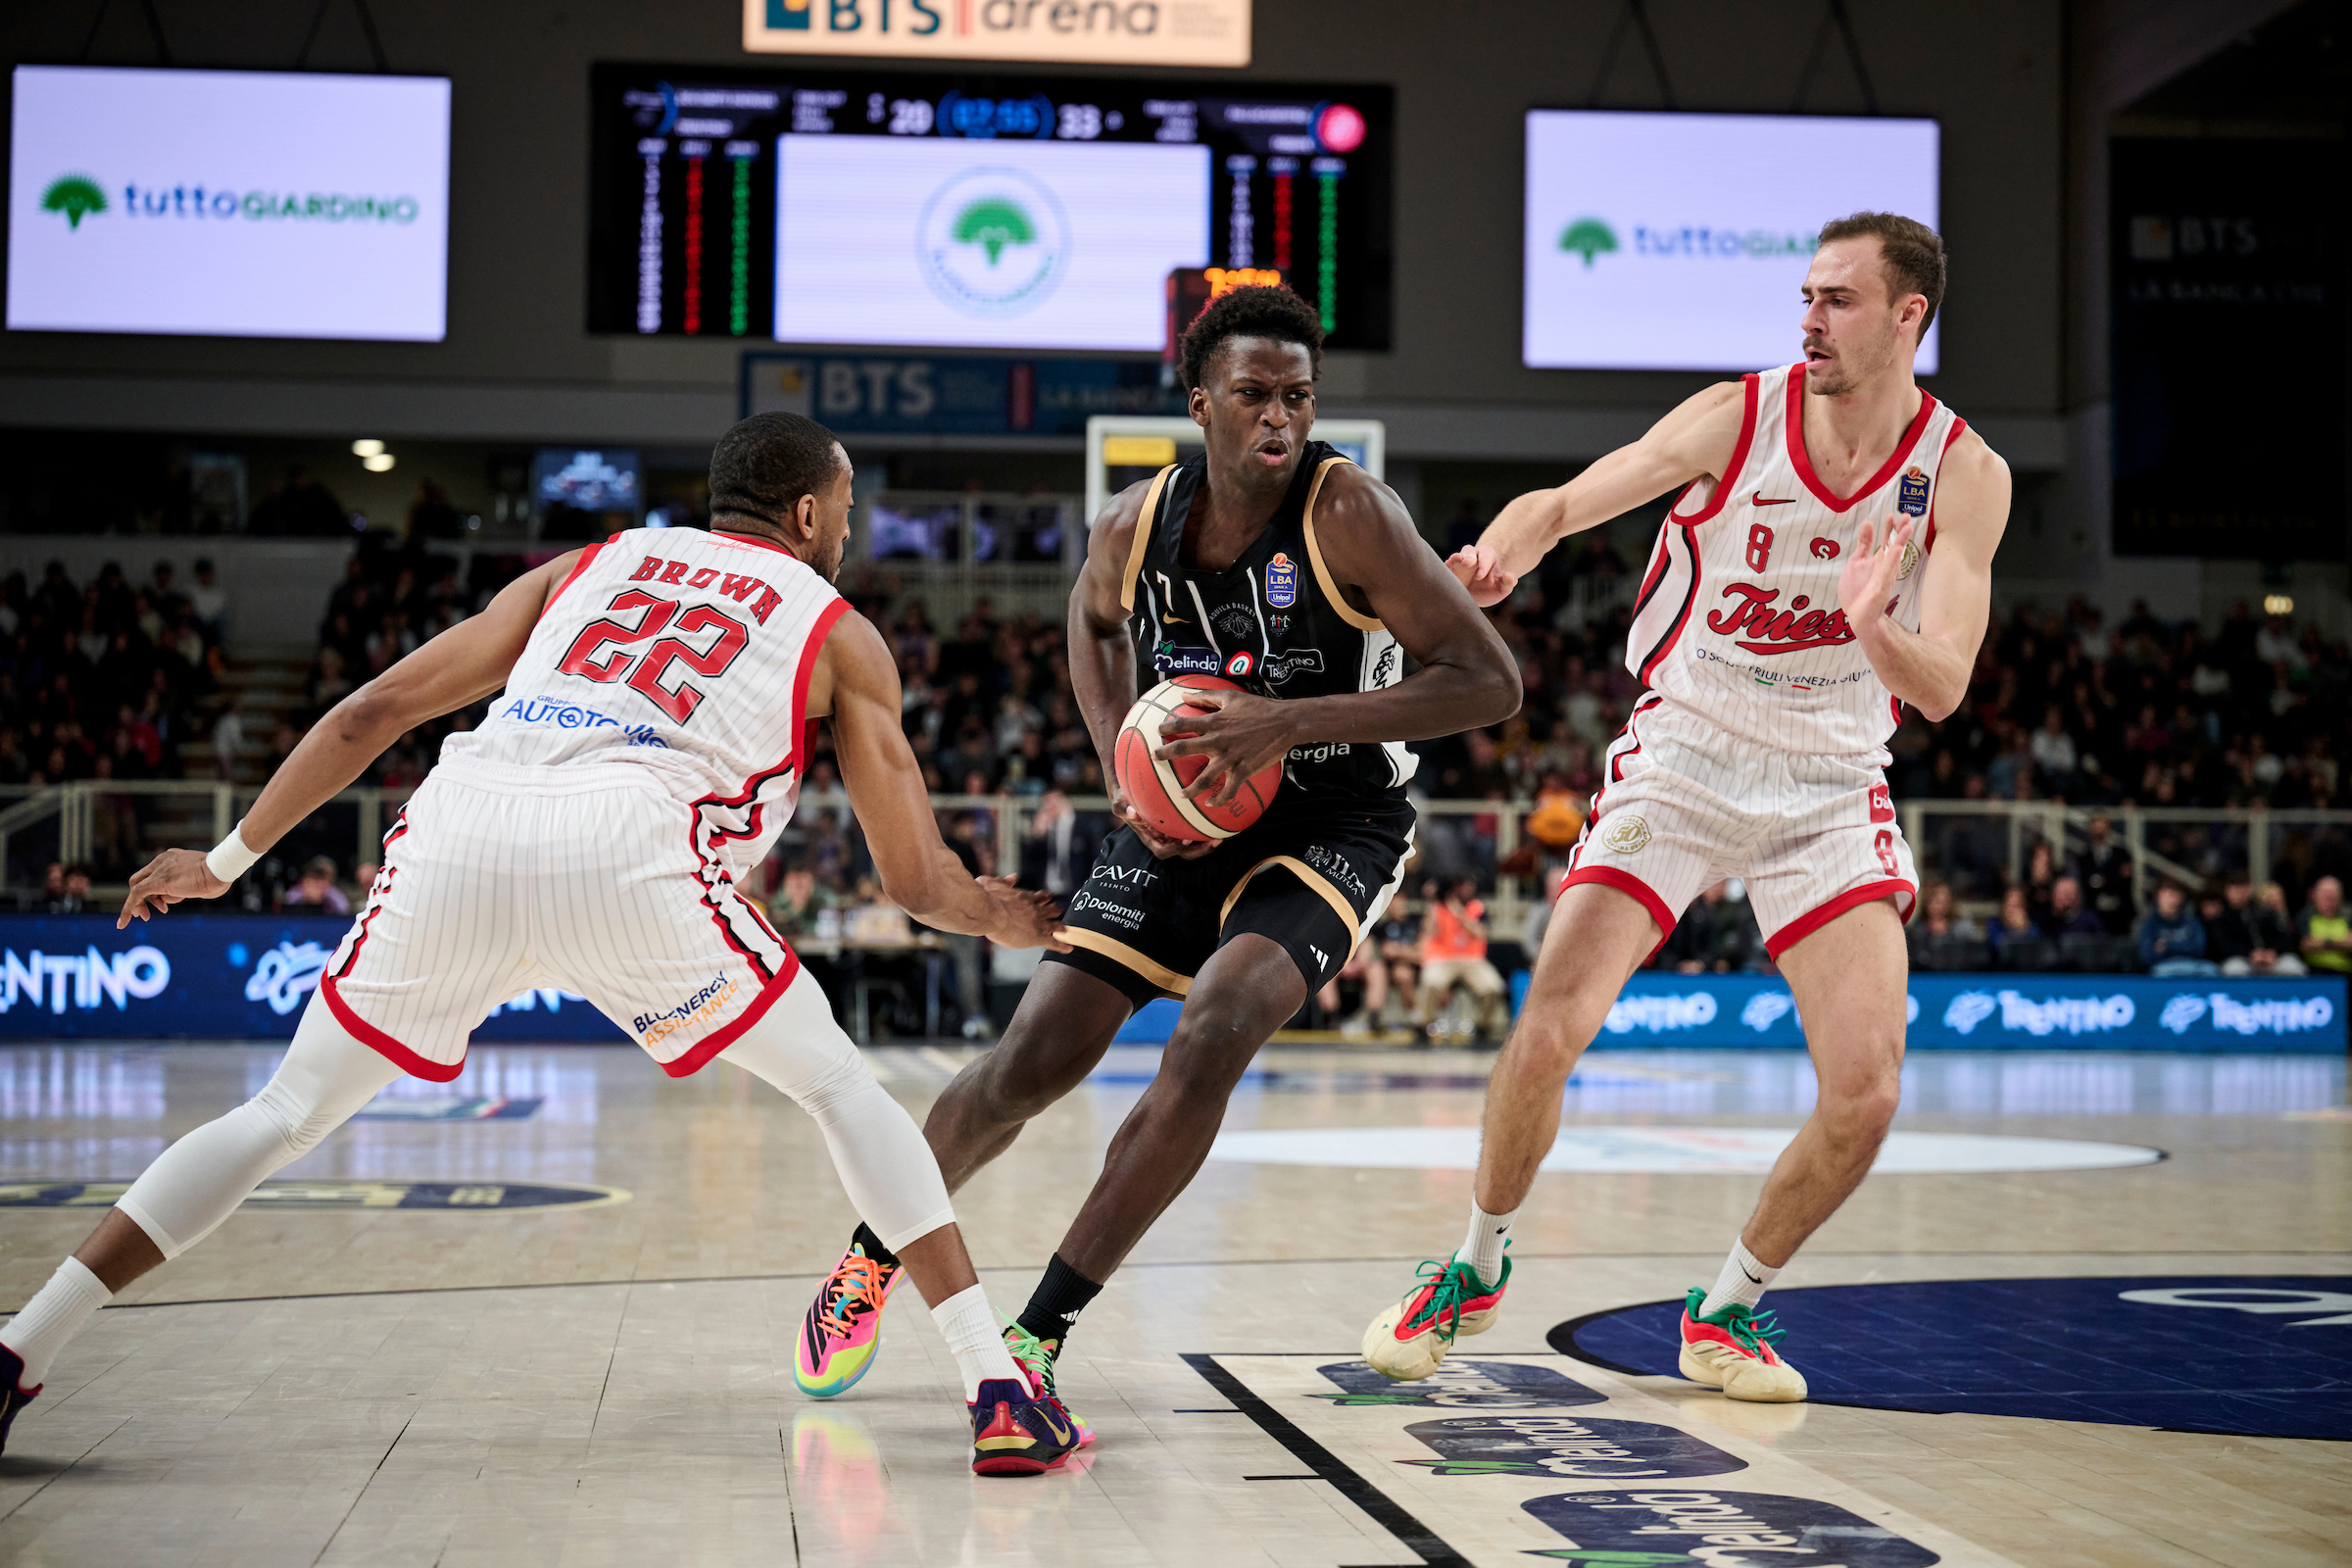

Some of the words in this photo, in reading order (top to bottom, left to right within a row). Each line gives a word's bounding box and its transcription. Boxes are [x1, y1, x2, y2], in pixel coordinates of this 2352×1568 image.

[982, 0, 1158, 35] arena
[820, 362, 936, 415] BTS
[1903, 486, 1926, 497] LBA
[1903, 504, 1923, 513] Unipol
[1745, 522, 1774, 574] 8
[629, 556, 783, 626] BROWN
[1155, 570, 1175, 612] 7
[1270, 575, 1293, 584] LBA
[1208, 604, 1231, 621] AQUILA
[1232, 602, 1256, 617] BASKET
[1707, 582, 1857, 640] Tries
[554, 588, 750, 726] 22
[1153, 653, 1218, 671] Melinda
[1749, 664, 1784, 682] FRIULI
[1787, 675, 1837, 687] VENEZIA
[537, 695, 575, 706] GRUPPO
[1284, 742, 1350, 763] ergia
[1612, 825, 1642, 843] 50
[1875, 829, 1899, 878] 8
[1092, 865, 1158, 888] CAVIT
[1100, 882, 1131, 893] TRENTO
[1326, 868, 1358, 896] MUTUA
[1088, 897, 1146, 922] Dolomiti
[1102, 912, 1140, 930] energia
[0, 945, 172, 1015] NTINO
[1464, 1418, 1668, 1477] Melinda
[1590, 1493, 1848, 1568] Melinda
